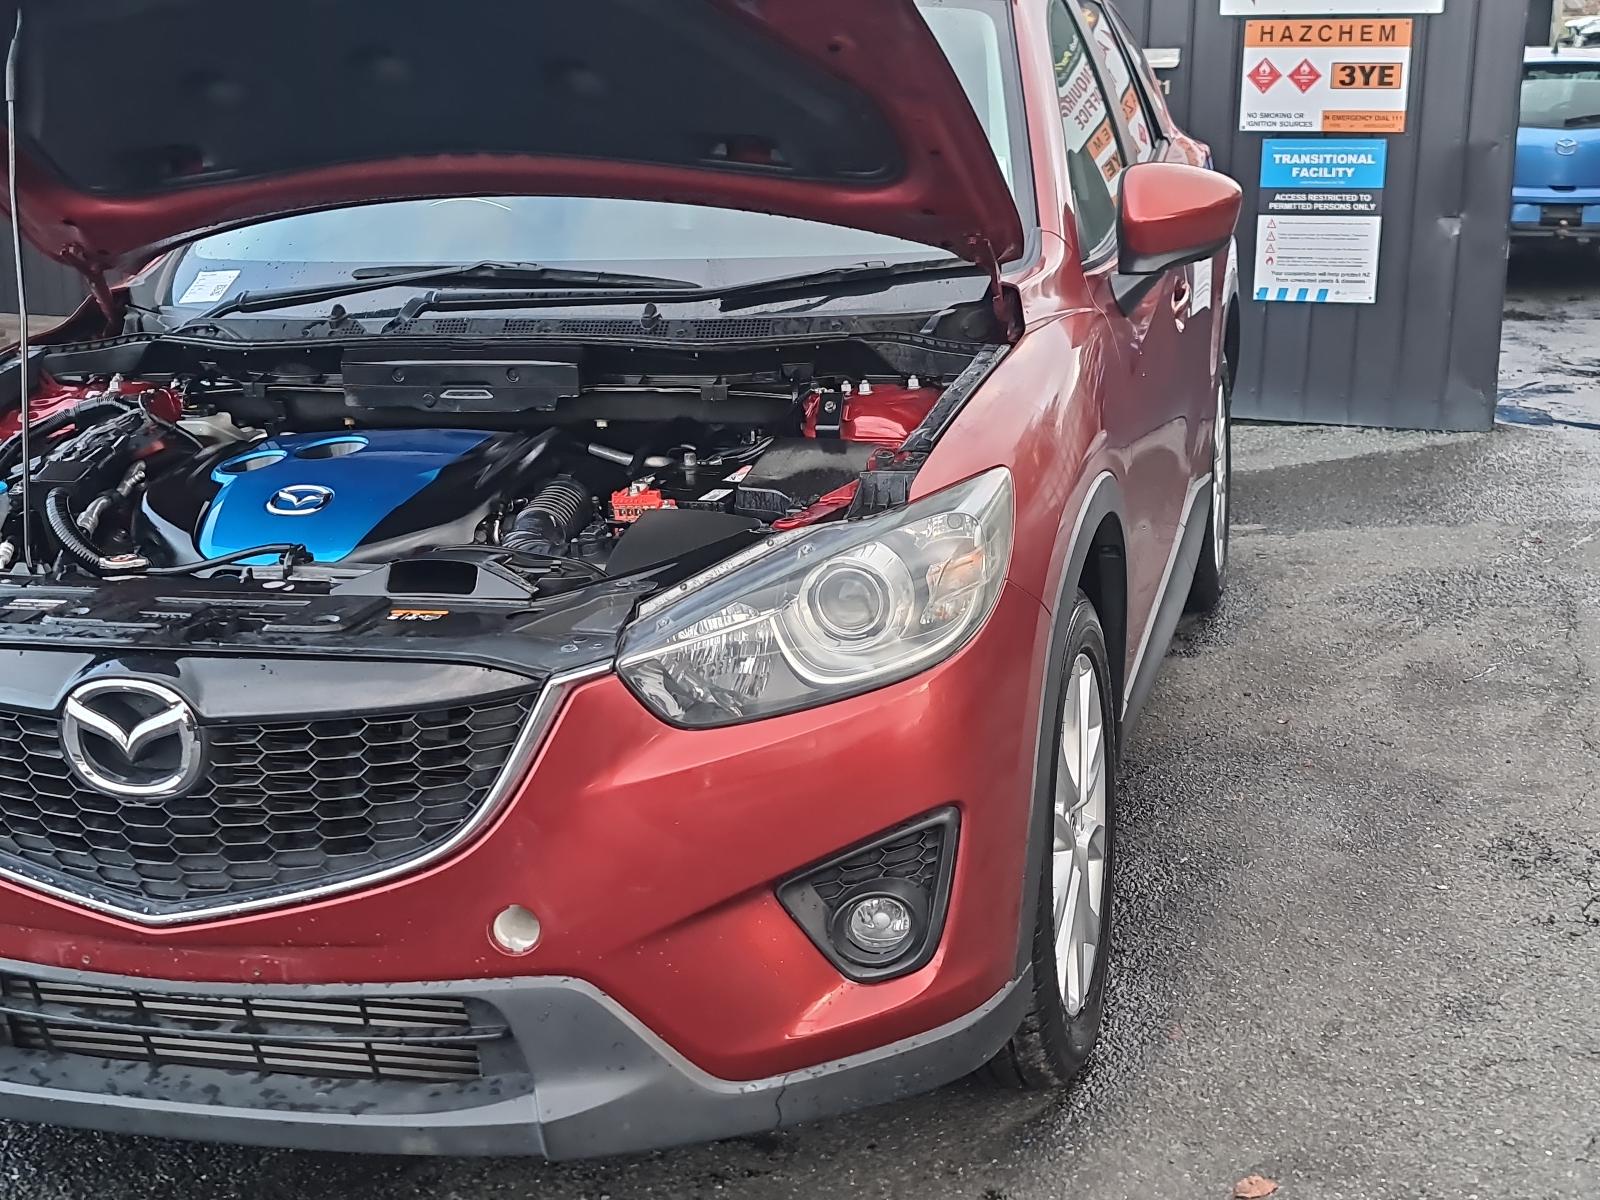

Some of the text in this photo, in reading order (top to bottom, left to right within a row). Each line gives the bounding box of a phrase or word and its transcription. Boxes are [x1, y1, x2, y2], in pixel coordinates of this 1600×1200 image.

[1260, 24, 1396, 43] HAZCHEM
[1339, 65, 1394, 87] 3YE
[1273, 153, 1376, 165] TRANSITIONAL
[1291, 167, 1355, 178] FACILITY
[1274, 193, 1373, 202] ACCESS RESTRICTED TO
[1268, 202, 1376, 211] PERMITTED PERSONS ONLY
